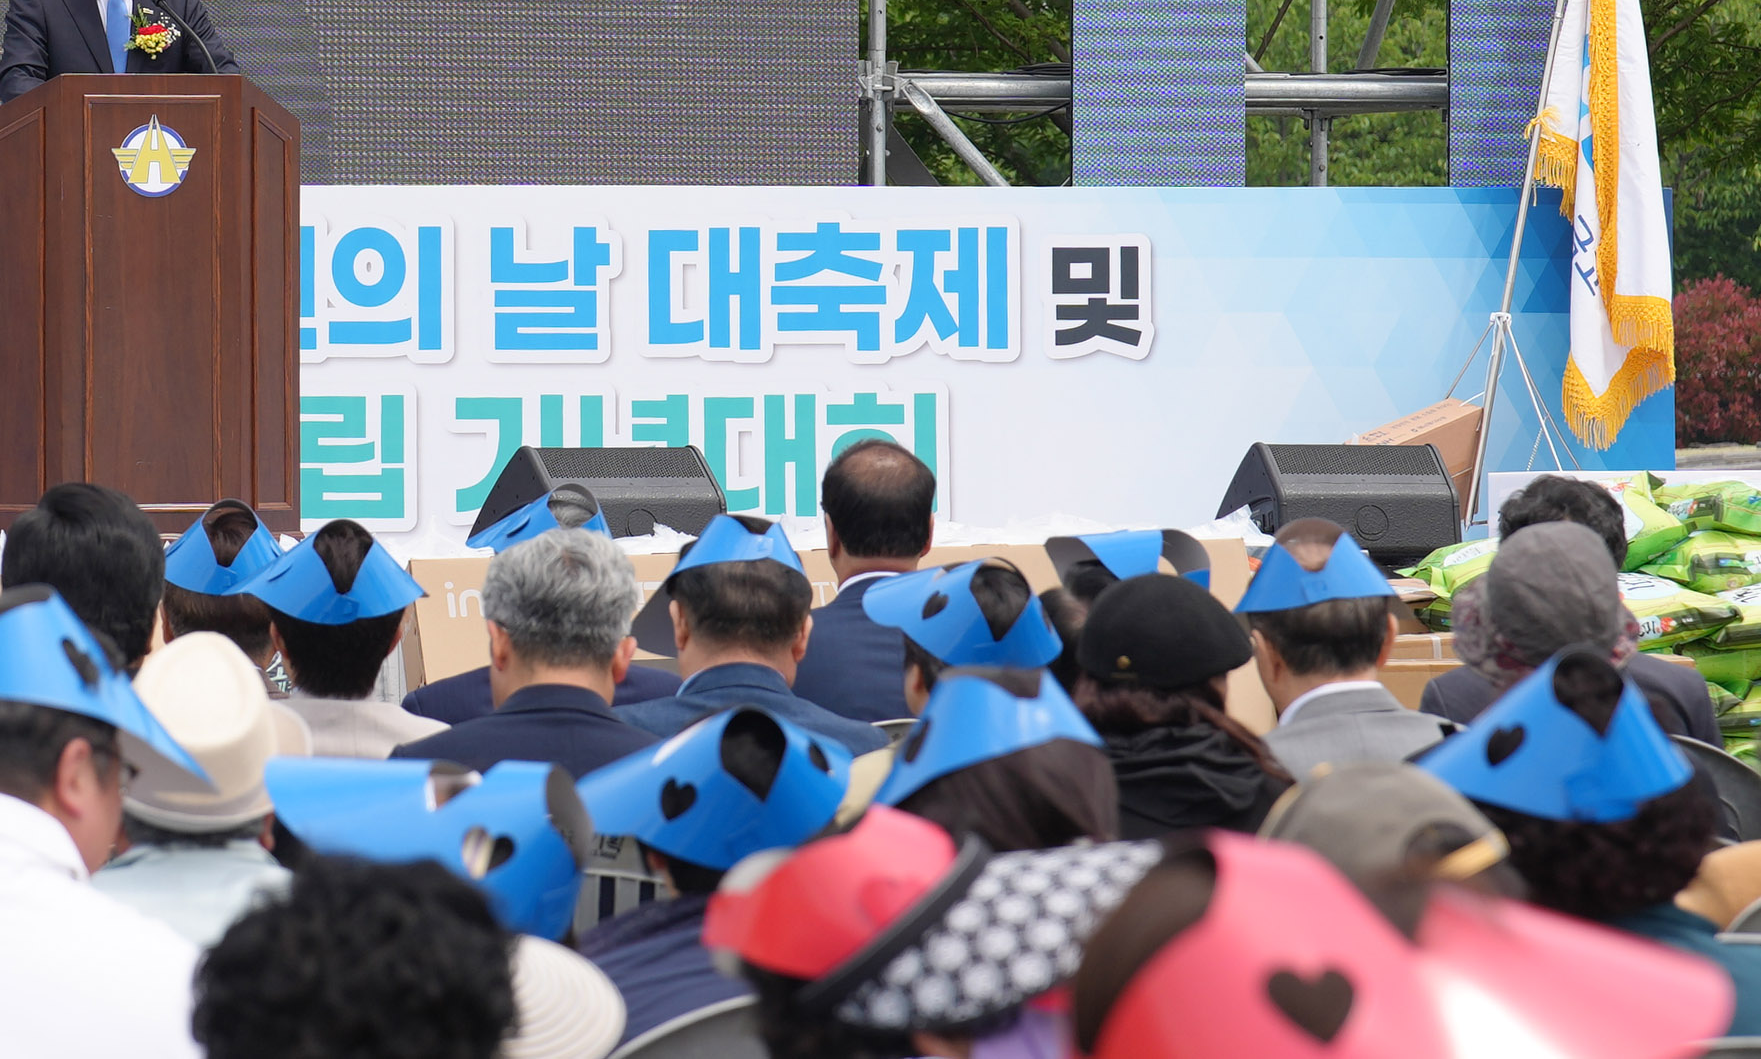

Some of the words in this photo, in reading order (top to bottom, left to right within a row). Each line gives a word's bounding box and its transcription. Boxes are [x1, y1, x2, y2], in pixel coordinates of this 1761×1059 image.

[490, 226, 610, 351] 날
[648, 222, 1008, 351] 대축제
[1051, 245, 1142, 347] 및
